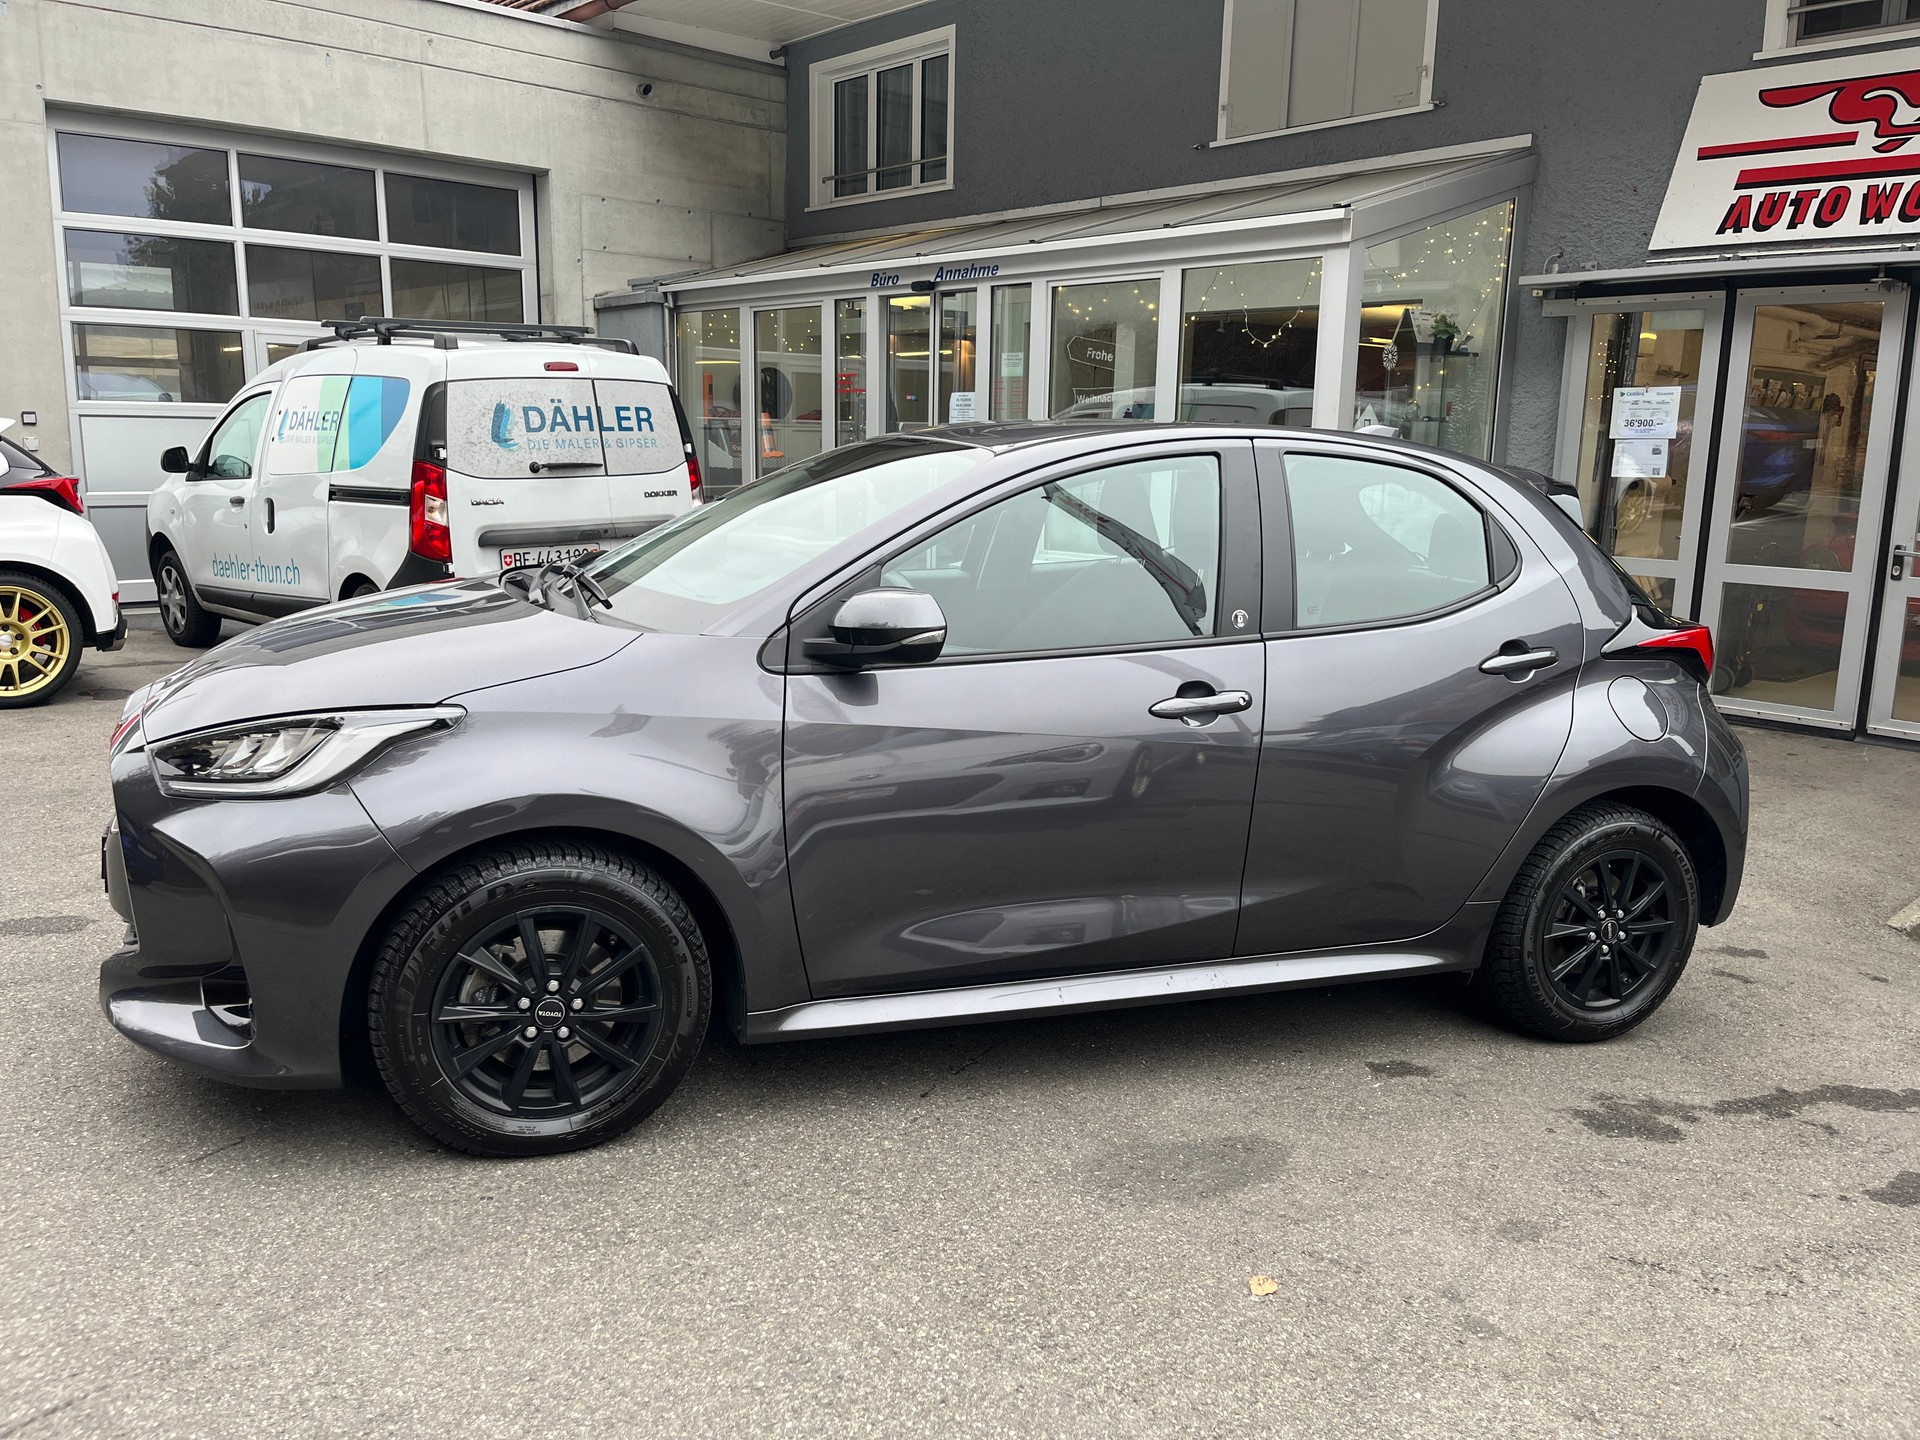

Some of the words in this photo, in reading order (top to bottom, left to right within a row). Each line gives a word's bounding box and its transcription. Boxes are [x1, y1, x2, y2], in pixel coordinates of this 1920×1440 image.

[1715, 186, 1851, 235] AUTO
[871, 272, 899, 287] Büro
[934, 263, 999, 281] Annahme
[1086, 347, 1114, 362] Frohe
[289, 406, 340, 431] DÄHLER
[522, 398, 654, 433] DÄHLER
[527, 439, 549, 450] DIE
[556, 438, 599, 449] MALER
[604, 438, 611, 448] &
[616, 438, 658, 448] GIPSER
[470, 498, 504, 506] DACIA
[644, 490, 678, 498] DOKKER
[212, 552, 301, 585] daehler-thun.ch
[538, 1010, 562, 1018] TOYOTA
